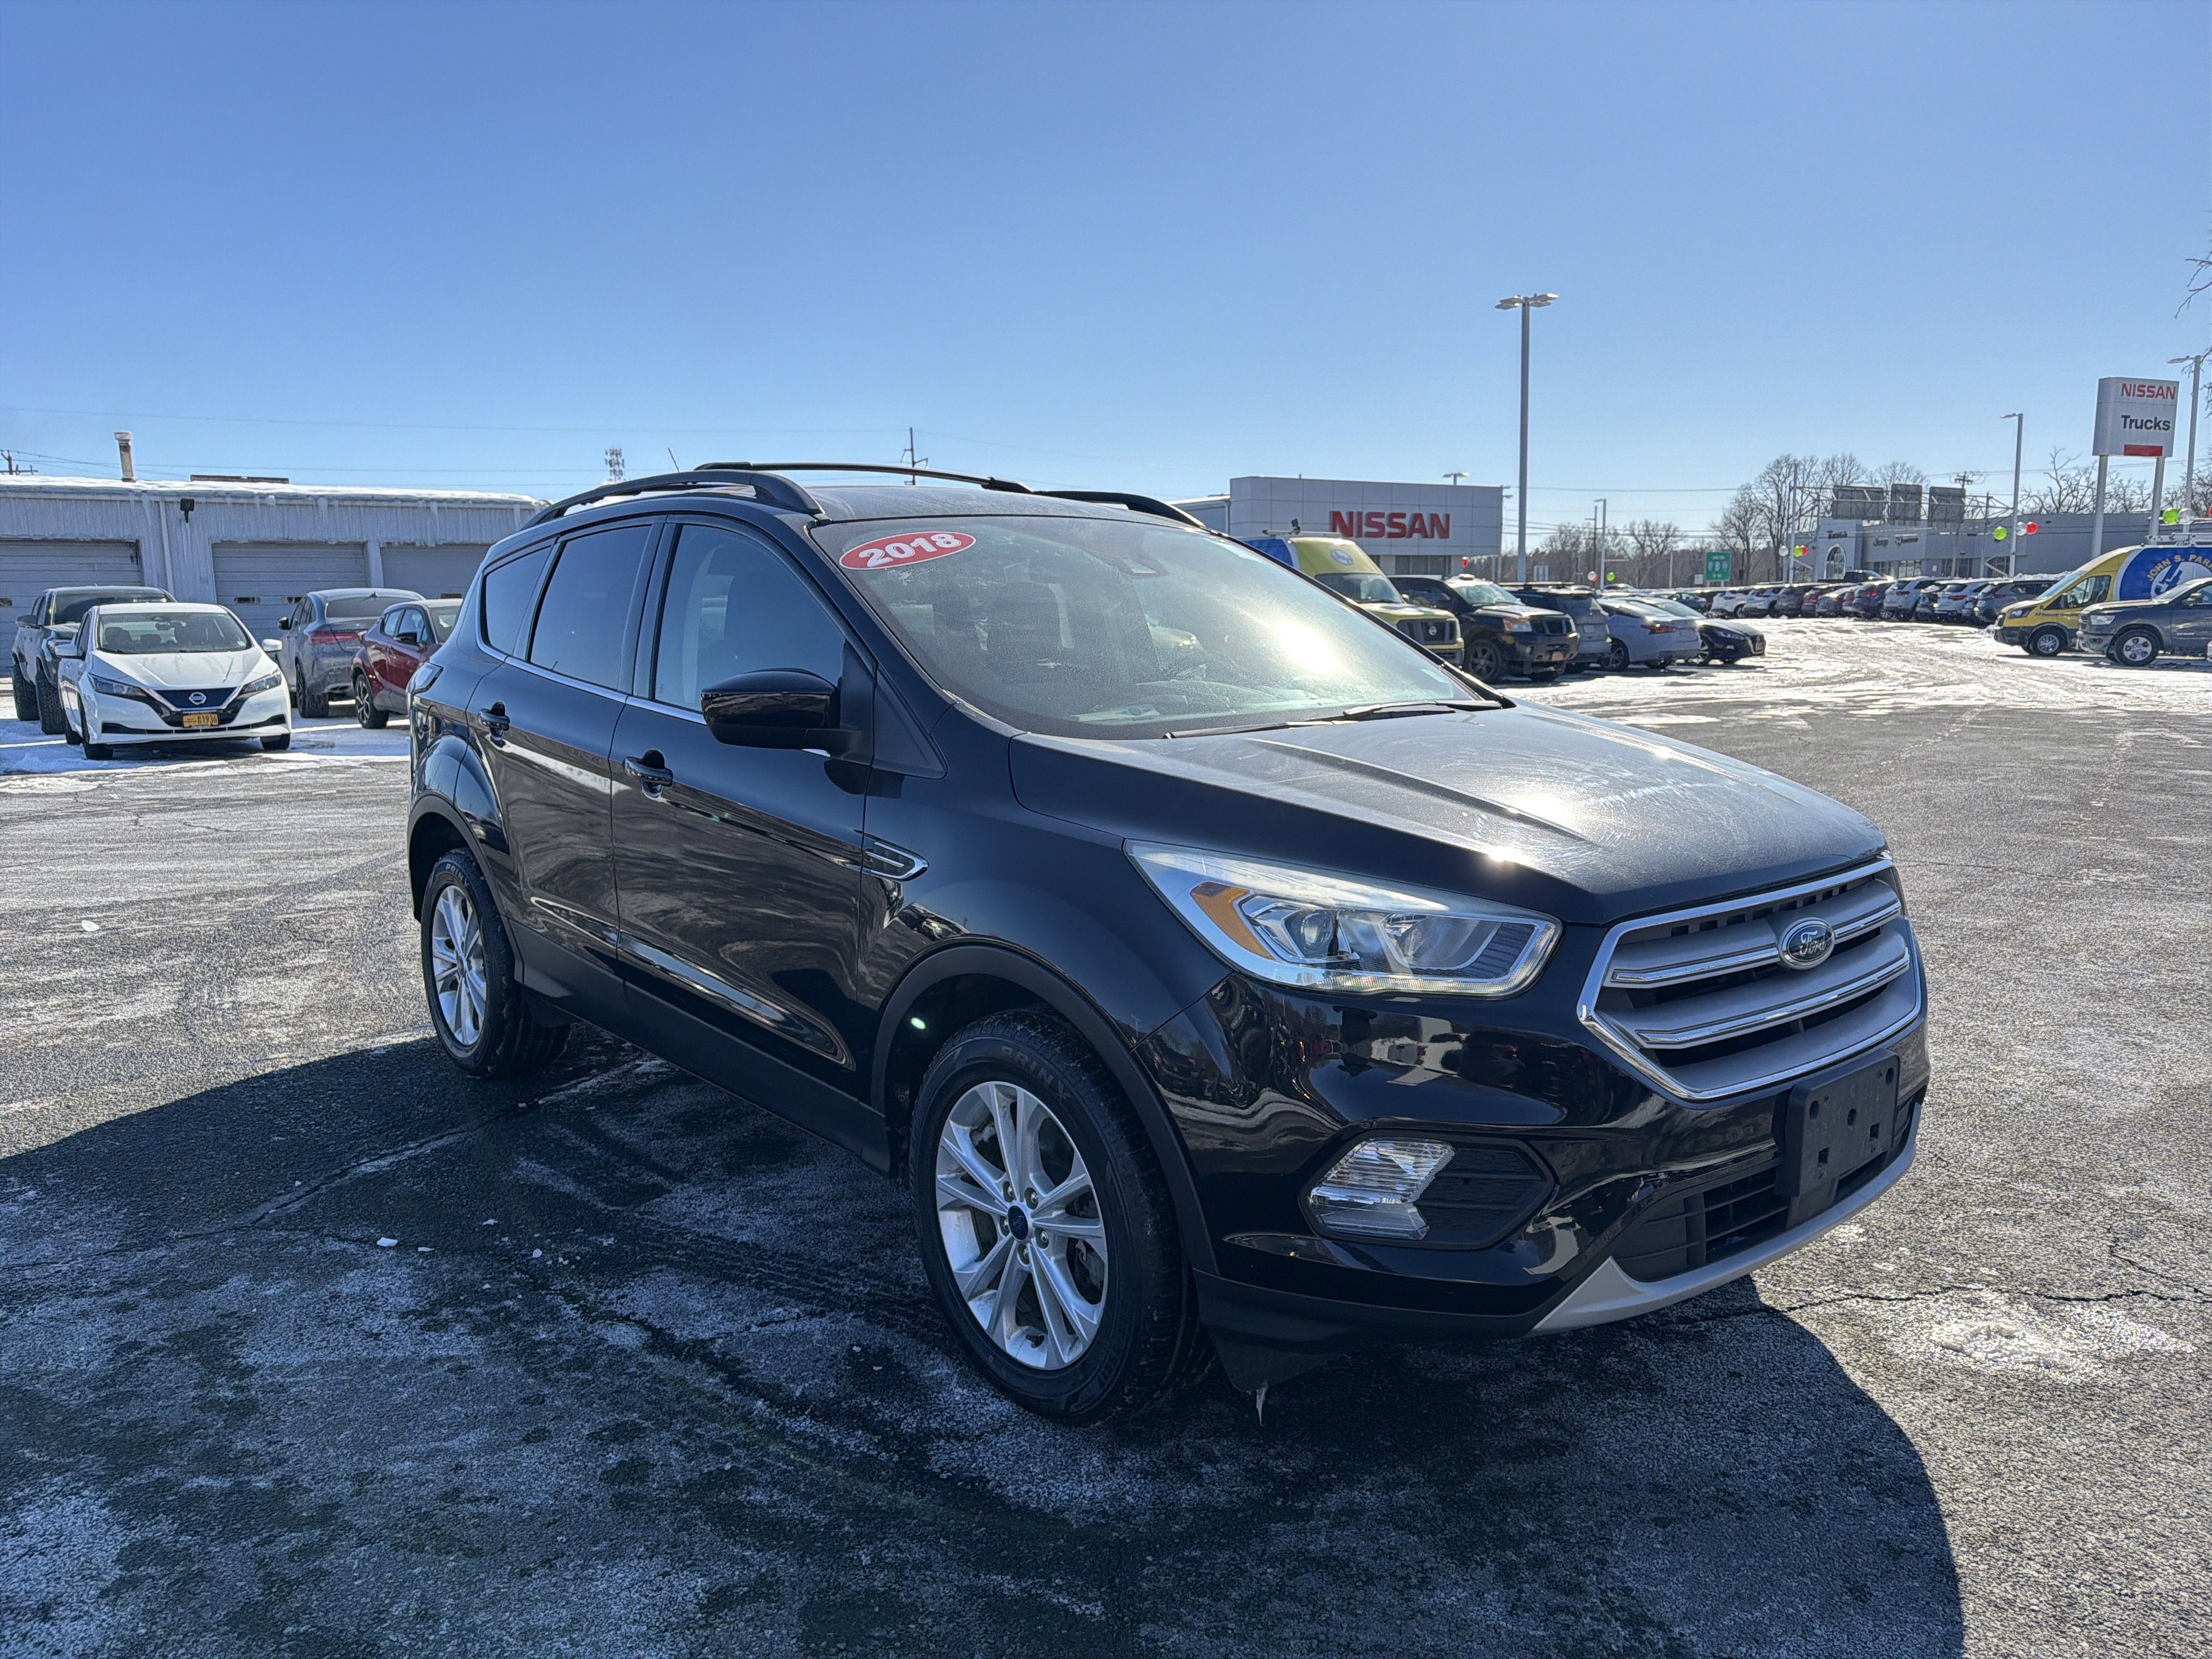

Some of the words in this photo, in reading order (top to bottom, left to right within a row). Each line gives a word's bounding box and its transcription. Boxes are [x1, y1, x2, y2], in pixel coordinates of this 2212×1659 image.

[2121, 383, 2176, 399] NISSAN
[2121, 415, 2171, 431] Trucks
[1331, 510, 1450, 539] NISSAN
[859, 534, 961, 567] 2018
[2147, 558, 2171, 582] JOHN
[446, 864, 470, 887] PRINX
[1799, 930, 1827, 957] Ford
[1001, 1045, 1070, 1101] PRINX
